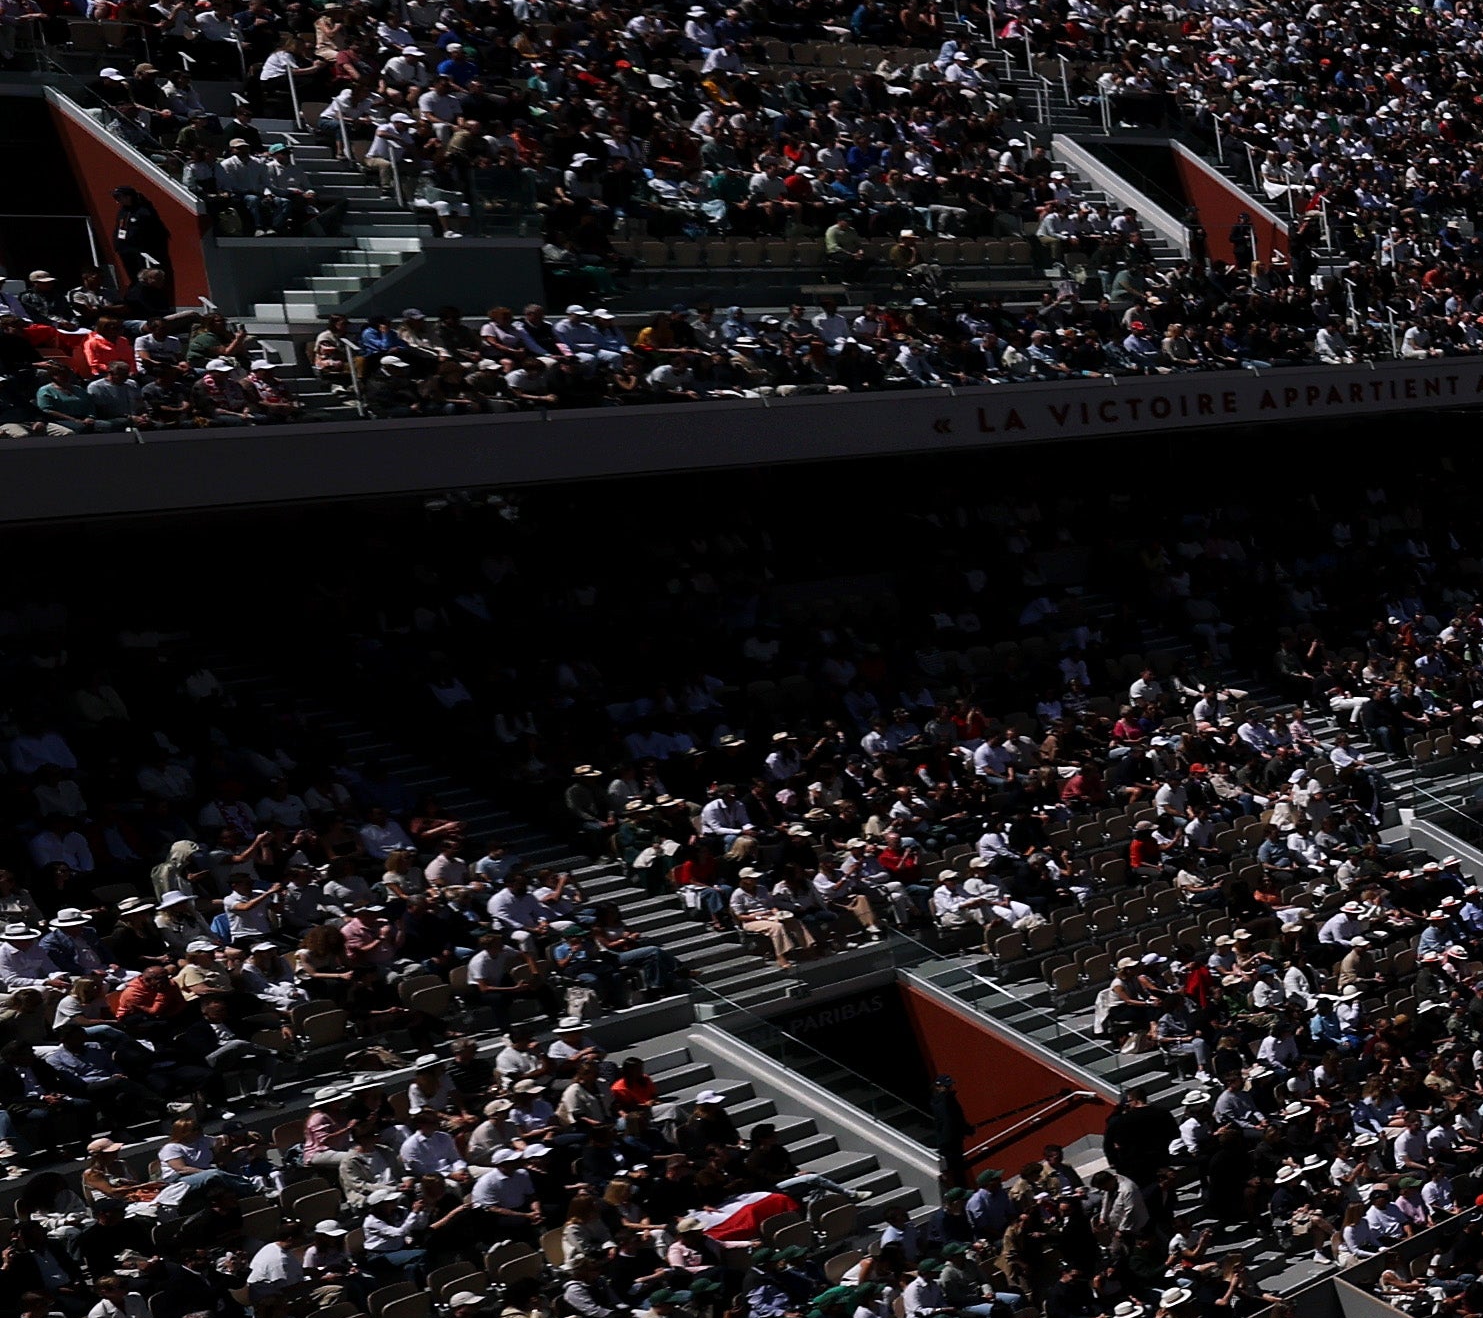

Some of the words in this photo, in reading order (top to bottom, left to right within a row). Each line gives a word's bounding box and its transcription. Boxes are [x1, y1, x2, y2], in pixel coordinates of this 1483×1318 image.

[978, 407, 1027, 434] LA
[1048, 391, 1237, 426] VICTOIRE
[1259, 376, 1458, 410] APPARTIENT
[789, 995, 884, 1033] PARIBAS
